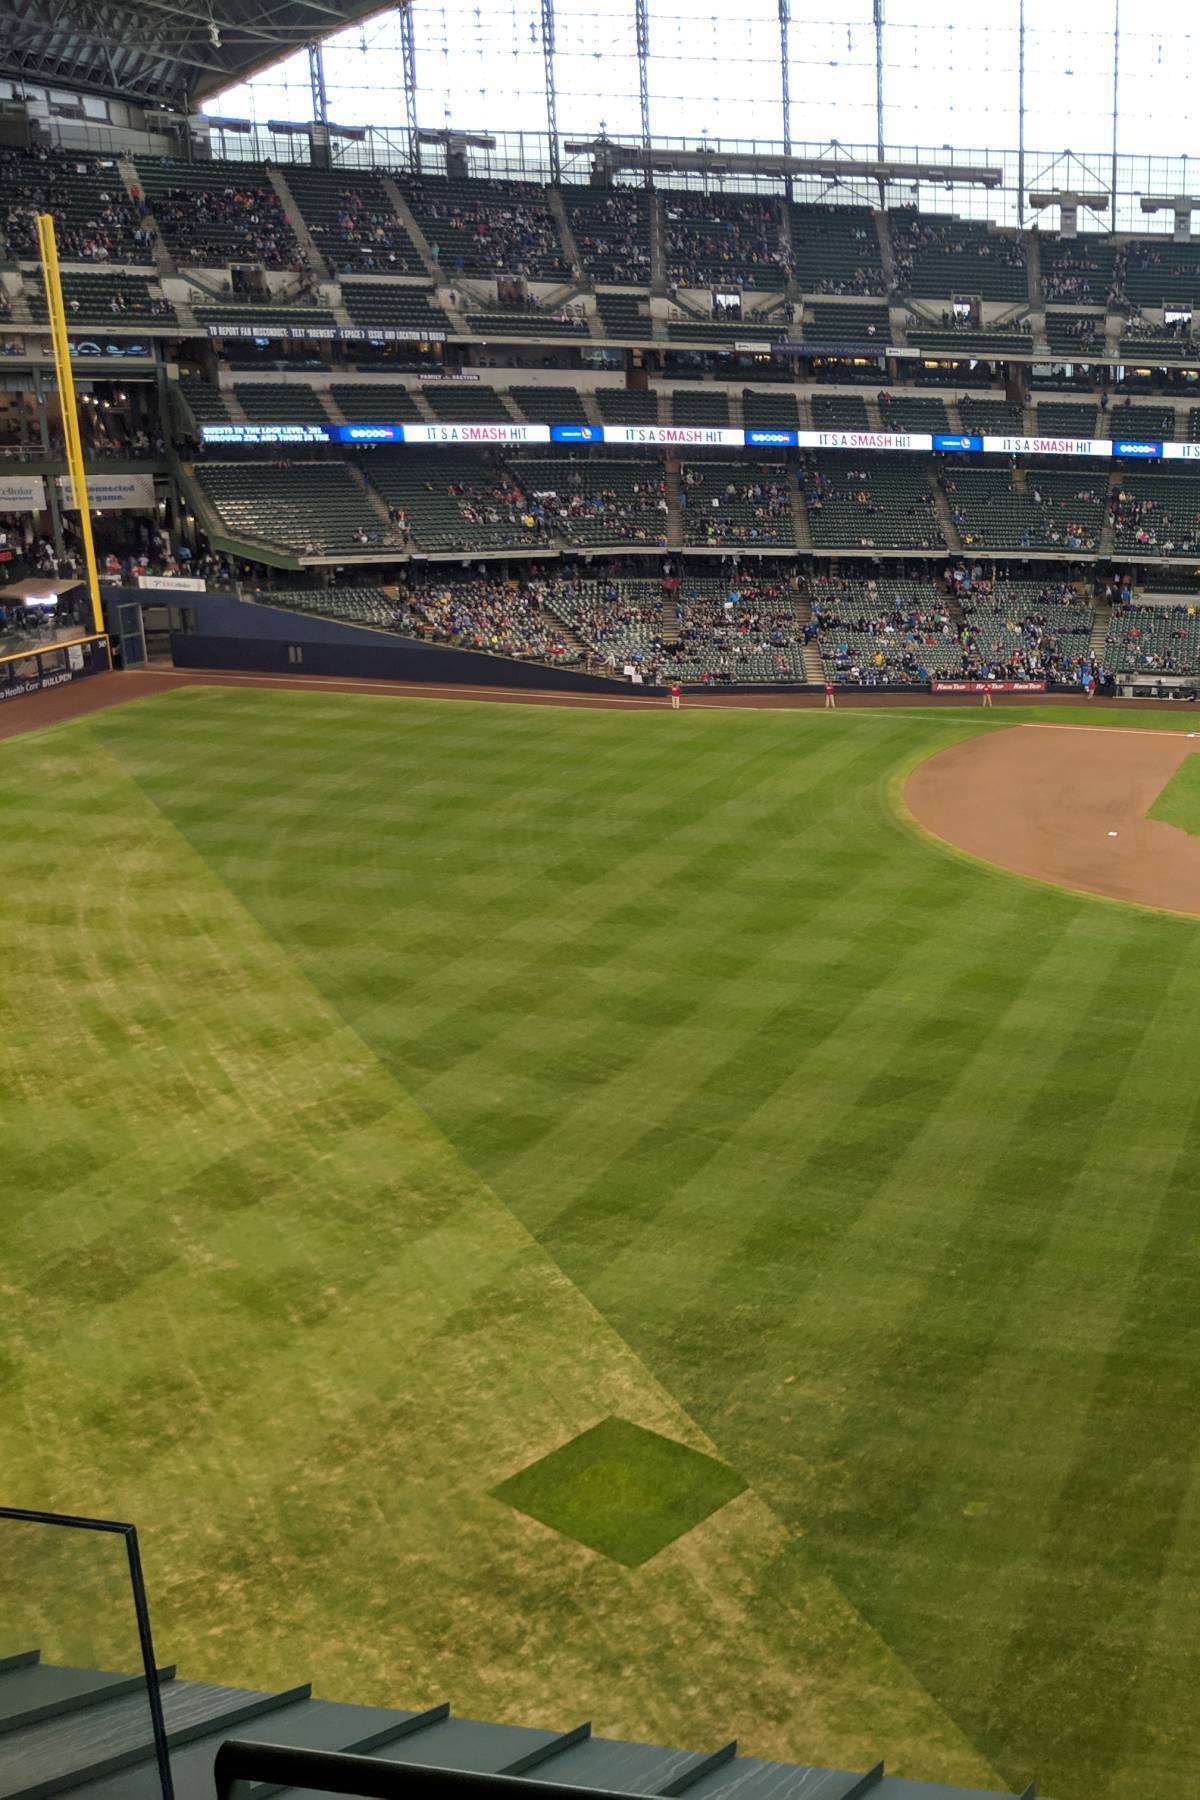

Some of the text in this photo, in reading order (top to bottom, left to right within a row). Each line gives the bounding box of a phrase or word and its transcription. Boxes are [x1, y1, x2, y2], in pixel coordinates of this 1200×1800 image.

[209, 326, 218, 336] TO
[218, 326, 239, 336] REPORT
[240, 327, 252, 336] FAN
[291, 328, 305, 337] TEXT
[384, 330, 395, 340] AND
[396, 330, 420, 340] LOCATION
[261, 434, 277, 442] AND
[452, 428, 458, 440] A
[462, 427, 506, 440] SMASH
[510, 427, 528, 440] HIT
[649, 430, 655, 441] A
[658, 429, 703, 442] SMASH
[706, 431, 723, 443] HIT
[841, 435, 848, 446] A
[850, 434, 892, 447] SMASH
[895, 435, 911, 447] HIT
[1024, 440, 1030, 451] A
[1033, 439, 1073, 452] SMASH
[1076, 441, 1092, 453] HIT
[0, 486, 33, 495] ellular
[4, 685, 25, 698] Health
[42, 672, 72, 688] BULLPEN
